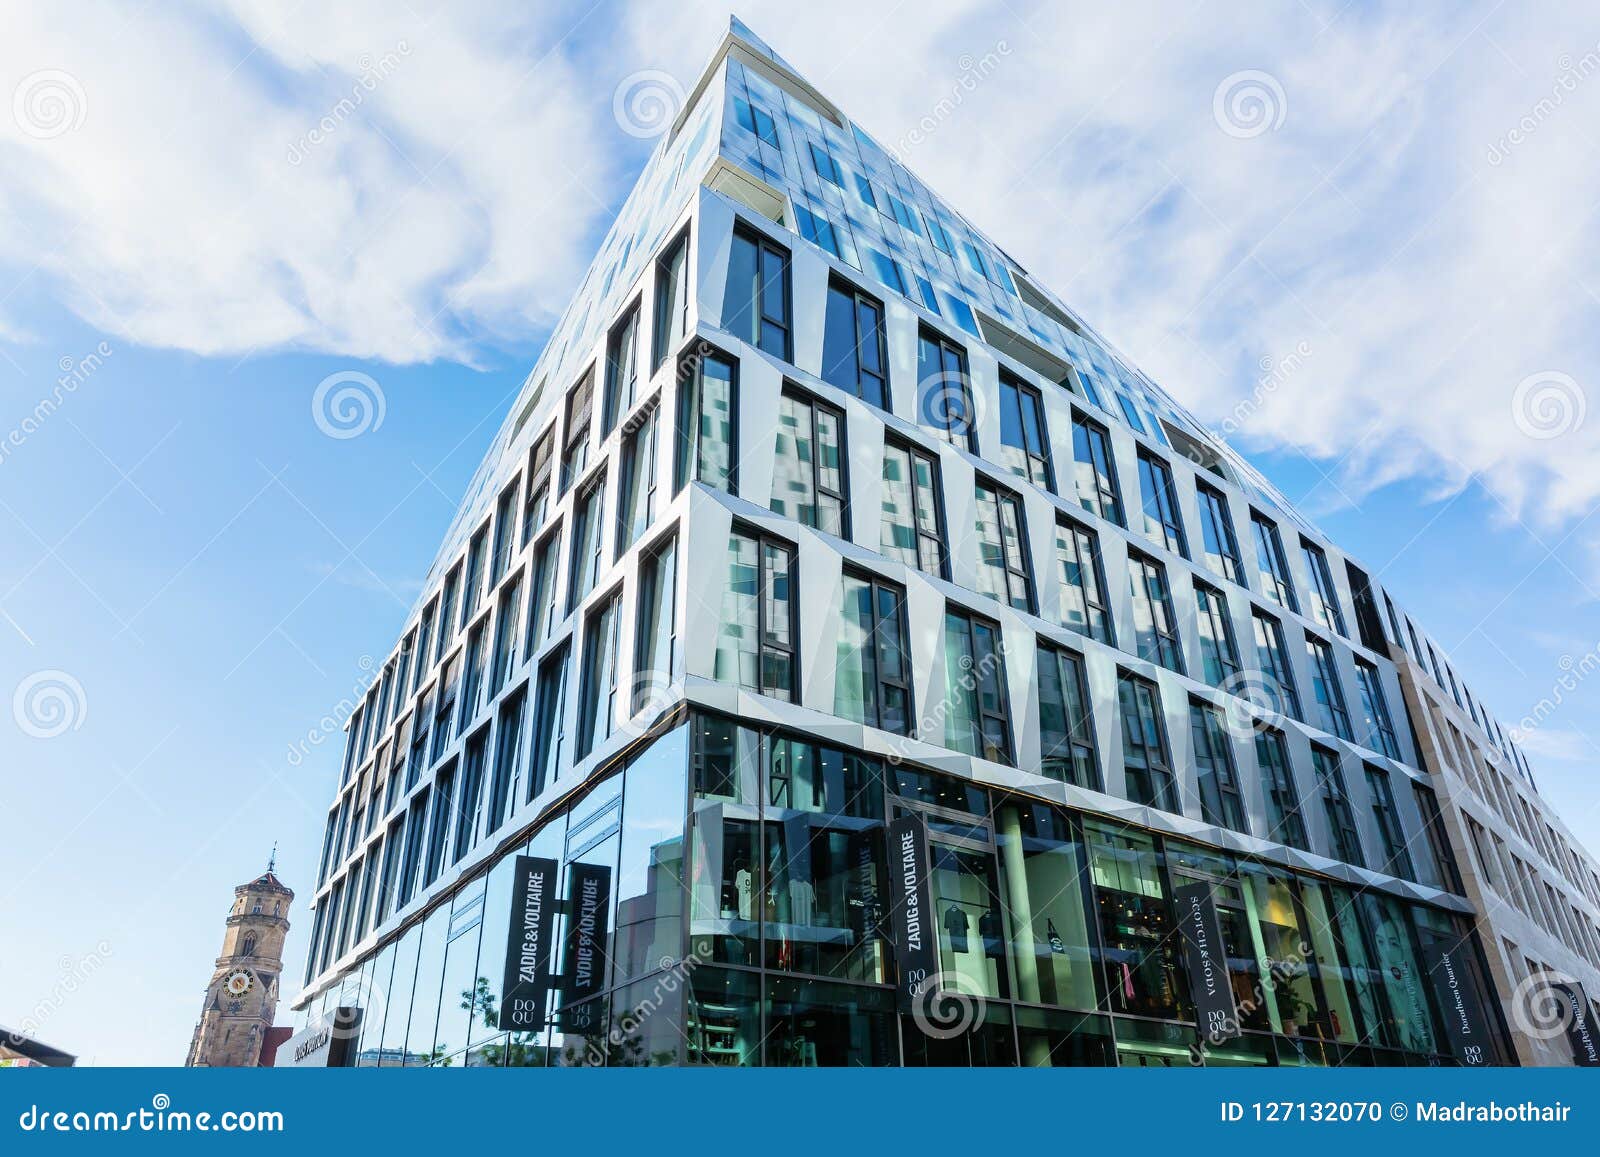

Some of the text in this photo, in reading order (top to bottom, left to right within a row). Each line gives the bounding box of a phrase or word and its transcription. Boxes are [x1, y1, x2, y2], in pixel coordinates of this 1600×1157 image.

[901, 829, 922, 953] ZADIG&VOLTAIRE
[519, 871, 544, 984] ZADIG&VOLTAIRE
[1190, 896, 1216, 996] SCOTCH&SODA
[514, 998, 535, 1011] DO
[1208, 1010, 1225, 1022] DO
[1441, 952, 1472, 1034] Dorotheen Quartier
[512, 1011, 534, 1024] QU
[1464, 1045, 1481, 1055] DO
